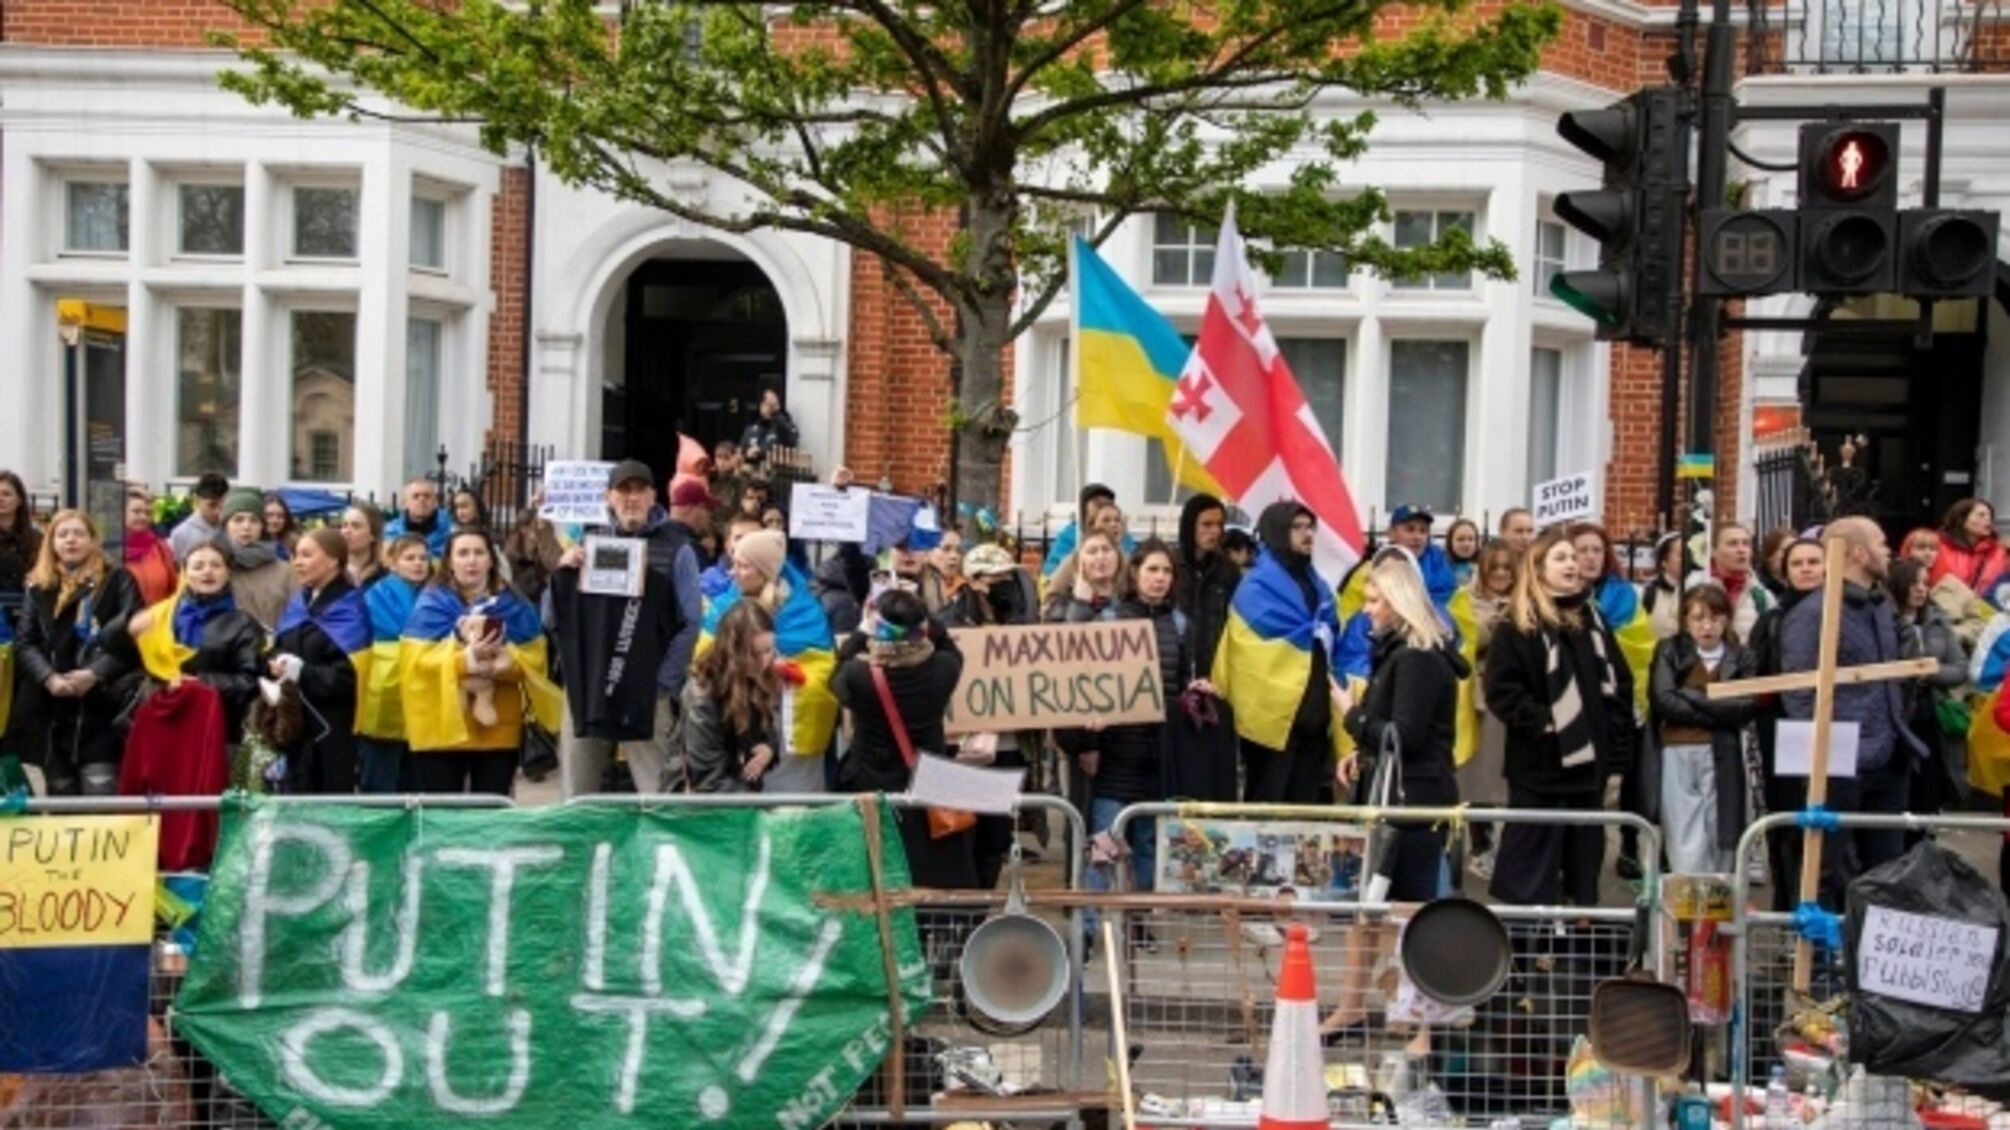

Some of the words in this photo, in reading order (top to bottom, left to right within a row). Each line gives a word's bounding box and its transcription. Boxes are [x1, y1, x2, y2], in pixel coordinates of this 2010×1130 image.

[1537, 495, 1589, 519] PUTIN
[1541, 477, 1586, 501] STOP
[983, 627, 1153, 668] MAXIMUM
[966, 675, 1015, 717] ON
[1027, 667, 1161, 716] RUSSIA
[8, 827, 130, 864] PUTIN
[45, 868, 82, 881] THE
[238, 818, 771, 1010] PUTIN
[776, 1064, 840, 1130] NOT
